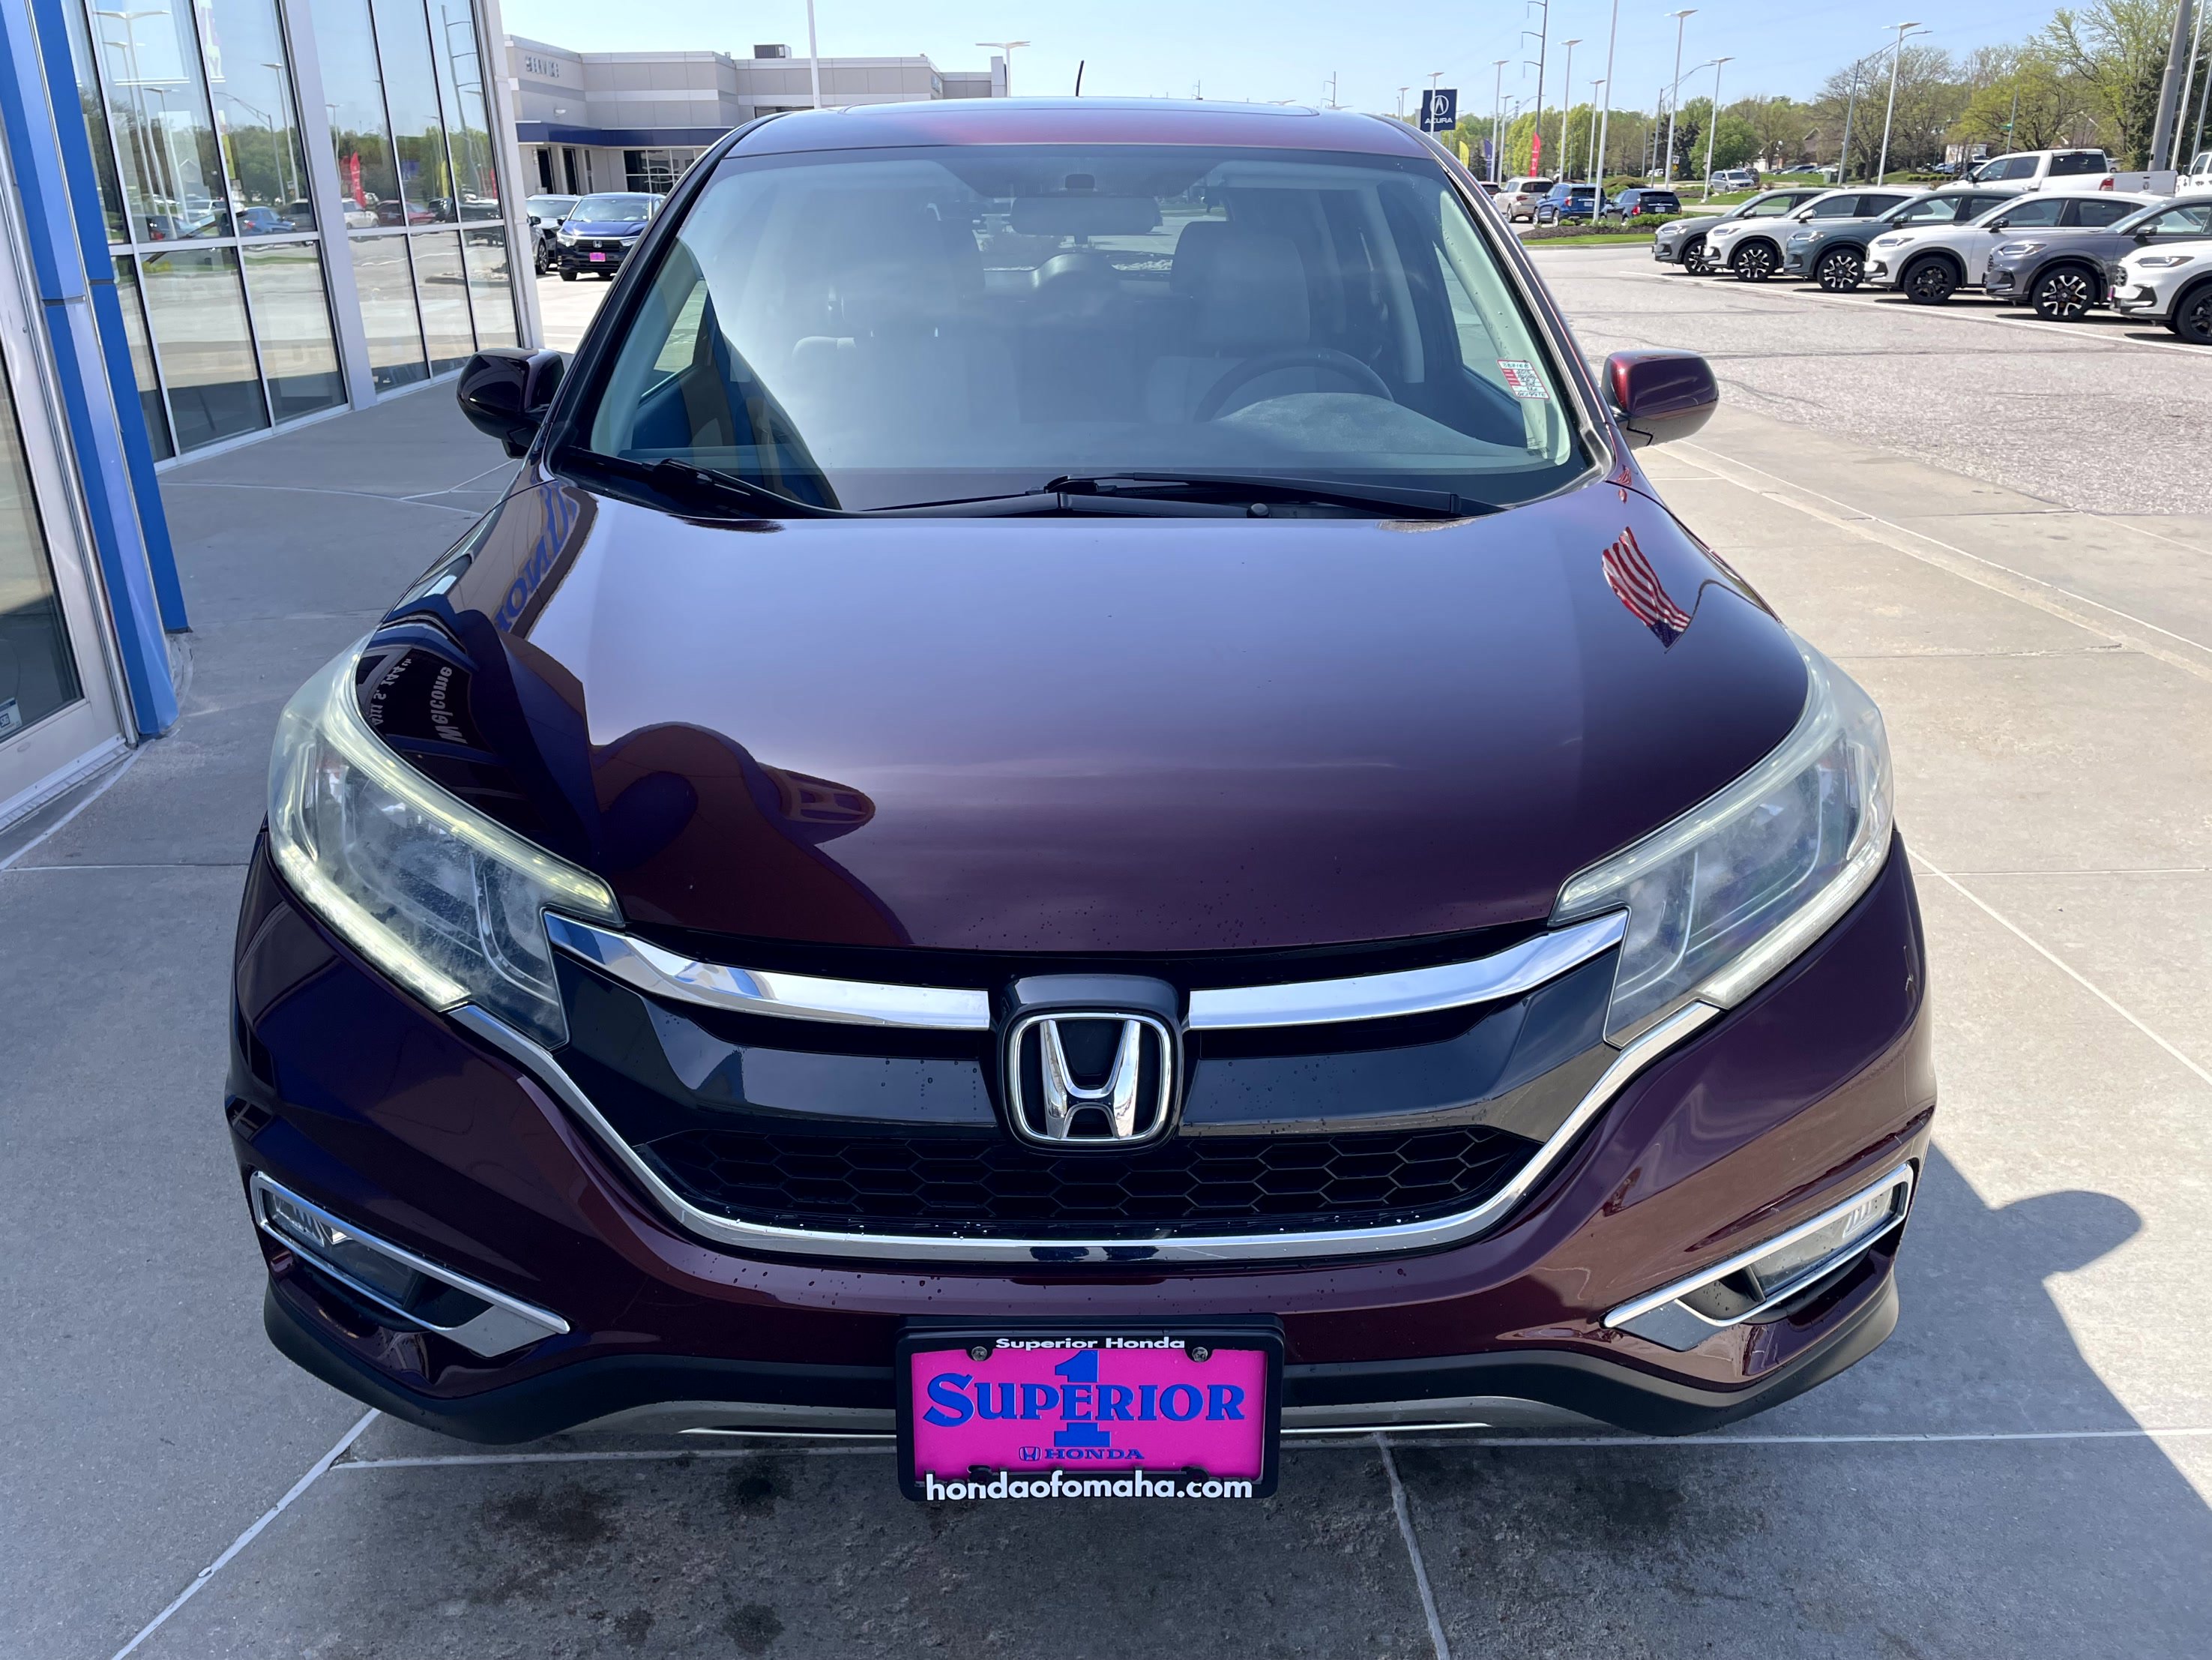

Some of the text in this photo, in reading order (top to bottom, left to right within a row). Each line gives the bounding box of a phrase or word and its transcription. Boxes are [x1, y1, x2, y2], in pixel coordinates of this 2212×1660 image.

[995, 1337, 1185, 1350] Superior Honda
[923, 1372, 1246, 1428] SUPERIOR
[1044, 1448, 1145, 1461] HONDA
[926, 1470, 1253, 1500] hondaofomaha.com
